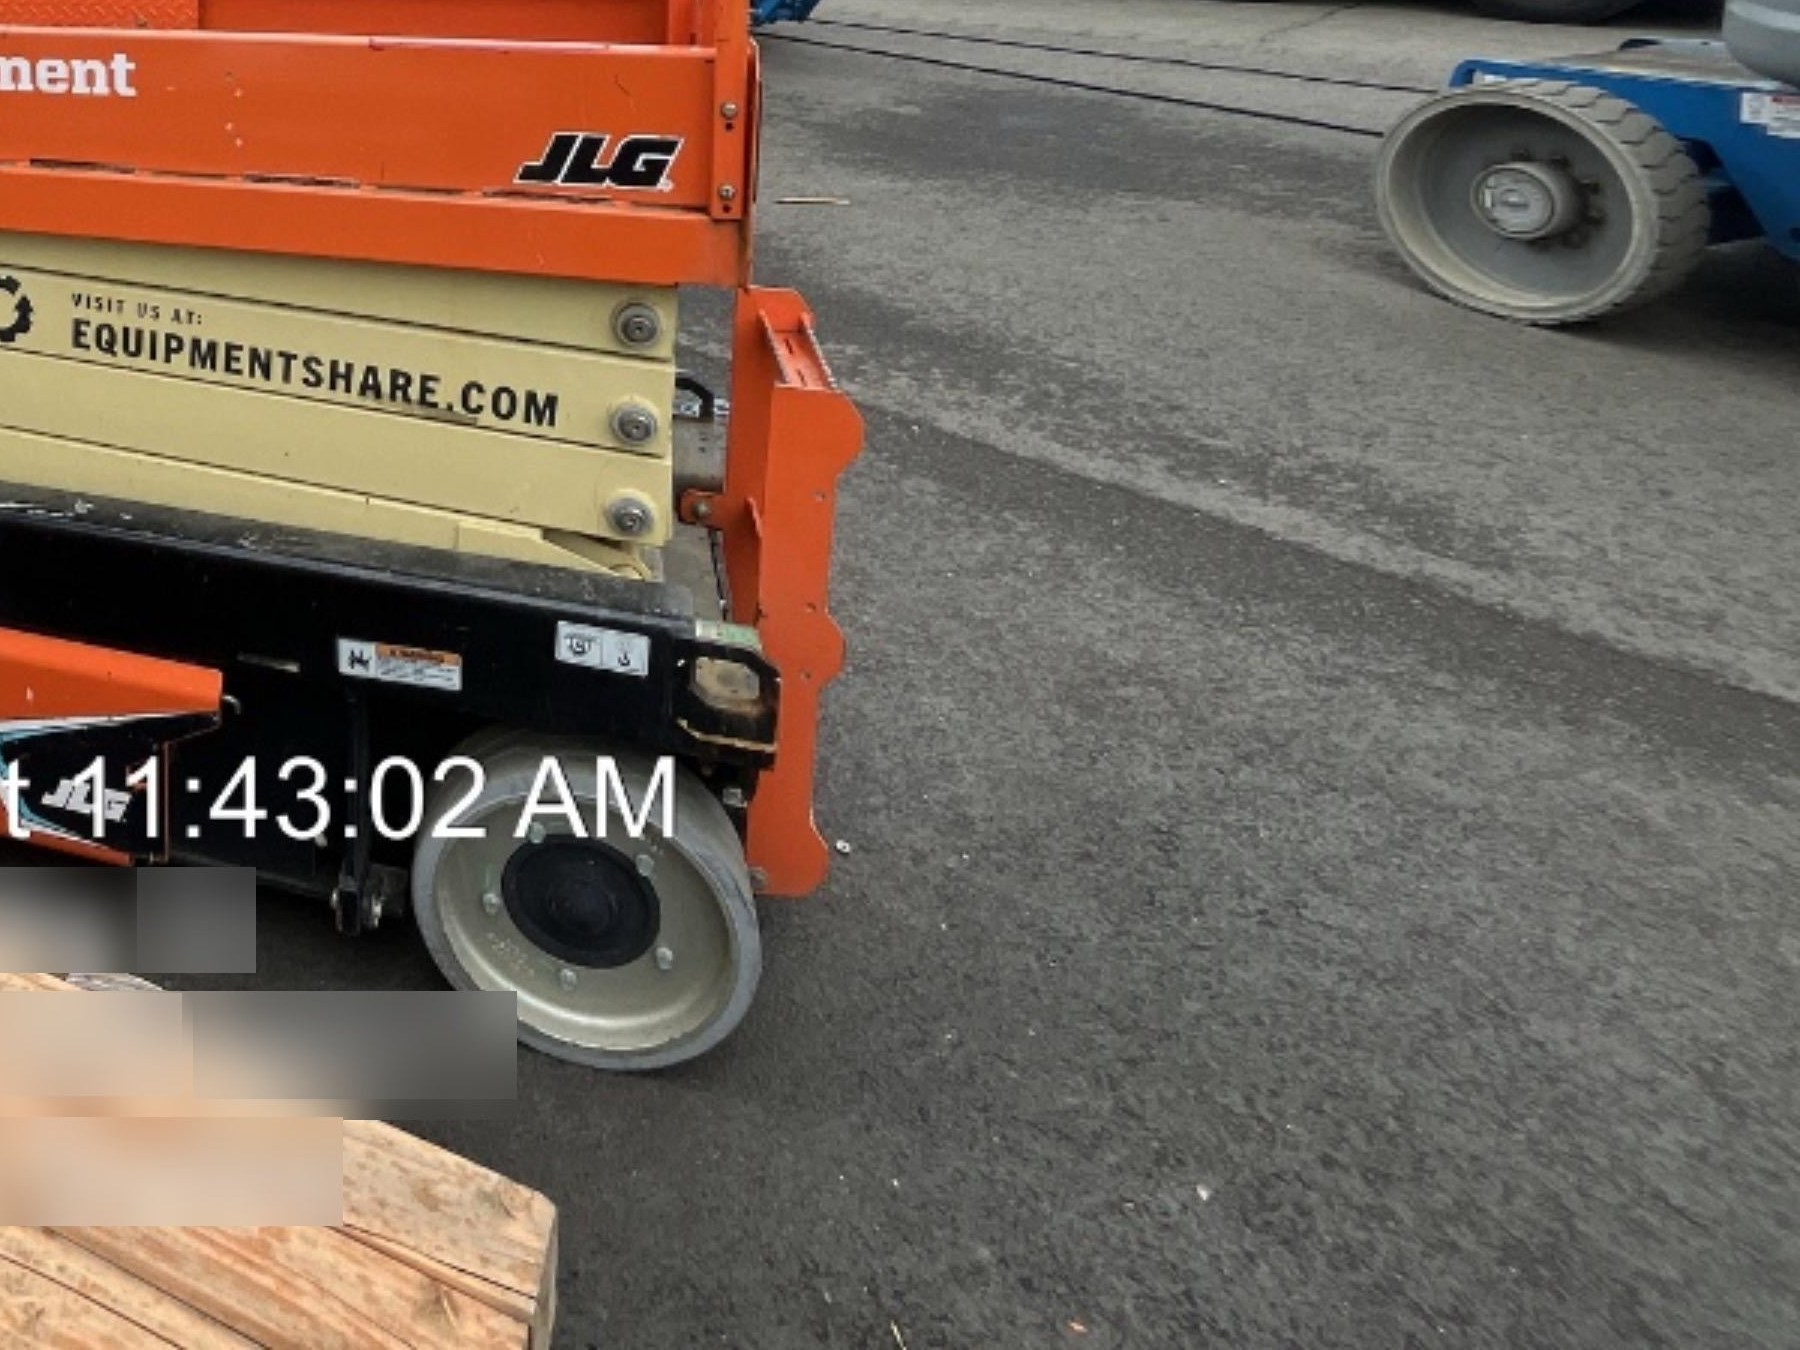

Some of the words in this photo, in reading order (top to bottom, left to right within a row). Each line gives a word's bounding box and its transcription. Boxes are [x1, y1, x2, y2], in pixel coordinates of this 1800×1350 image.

[513, 131, 685, 191] JLG
[72, 293, 125, 314] VISIT
[137, 303, 161, 320] US
[171, 307, 202, 326] AT:
[72, 317, 559, 427] EQUIPMENTSHARE.COM
